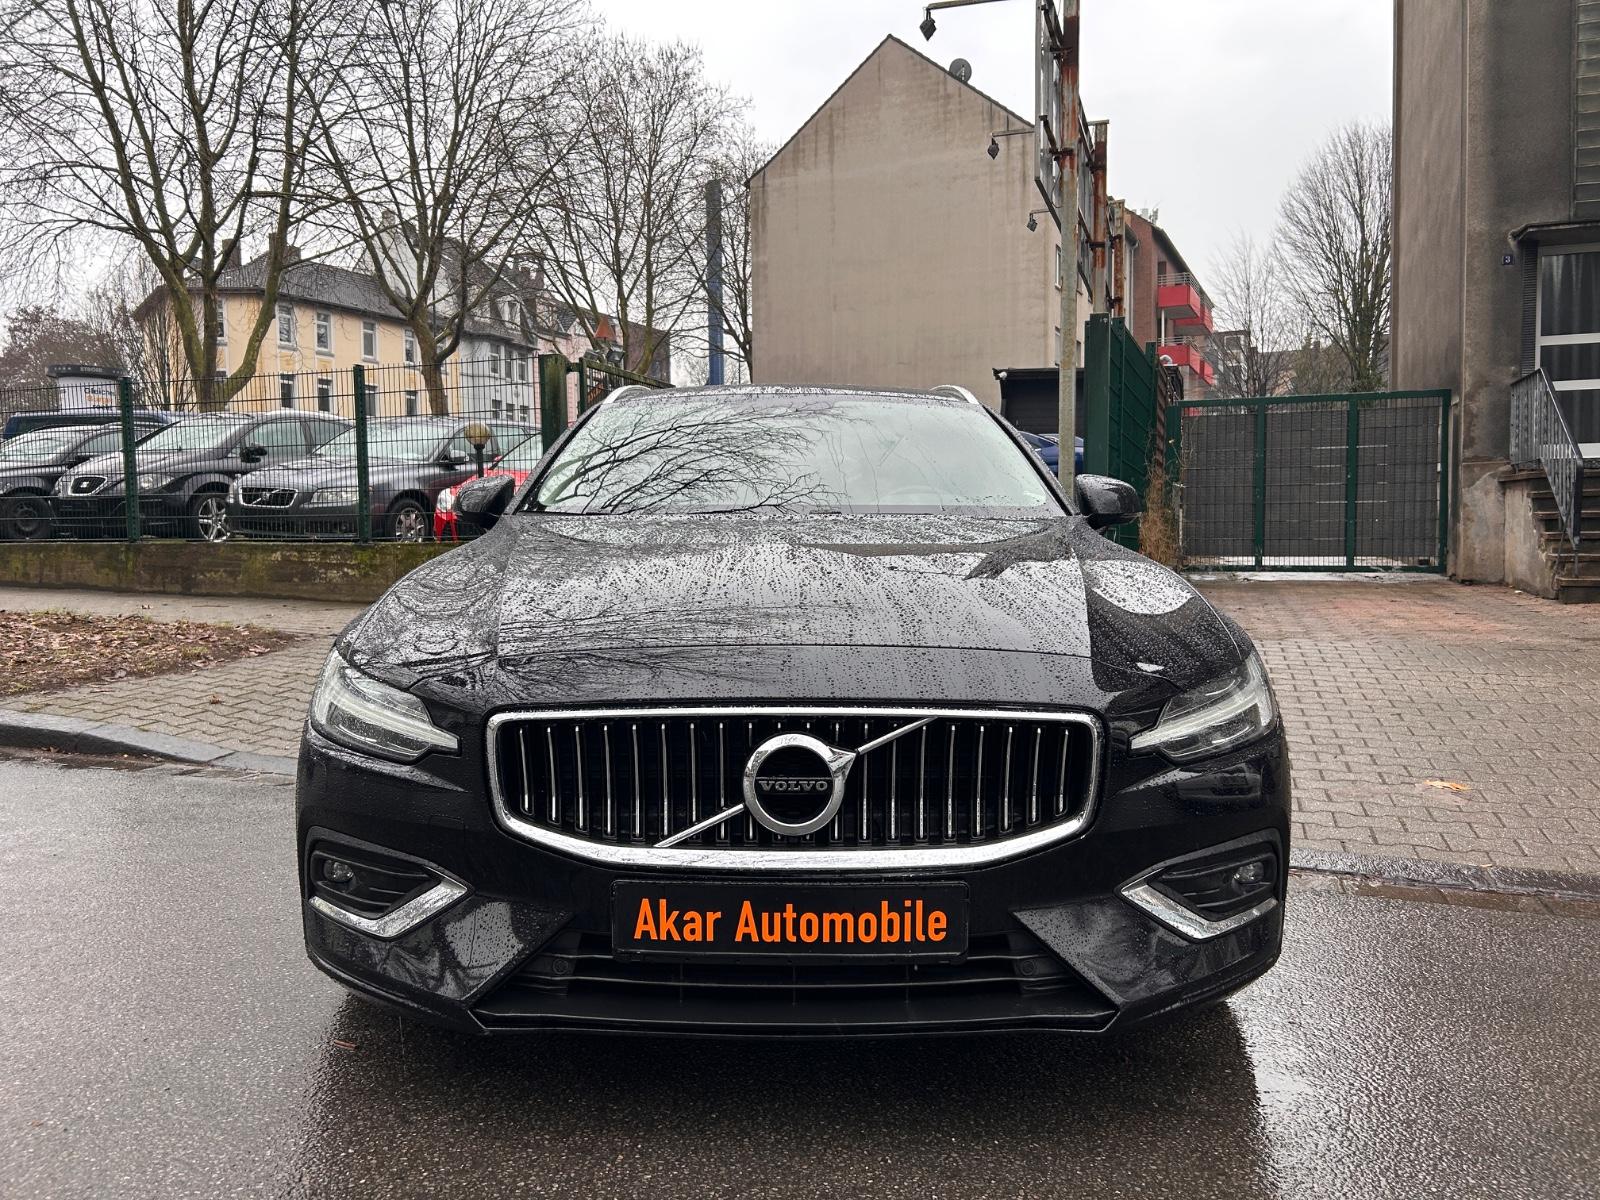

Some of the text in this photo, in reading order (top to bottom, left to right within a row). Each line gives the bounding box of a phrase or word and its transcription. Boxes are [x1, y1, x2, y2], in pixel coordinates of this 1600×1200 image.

[1504, 255, 1511, 264] 3
[758, 780, 828, 791] VOLVO
[634, 898, 947, 943] Akar Automobile
